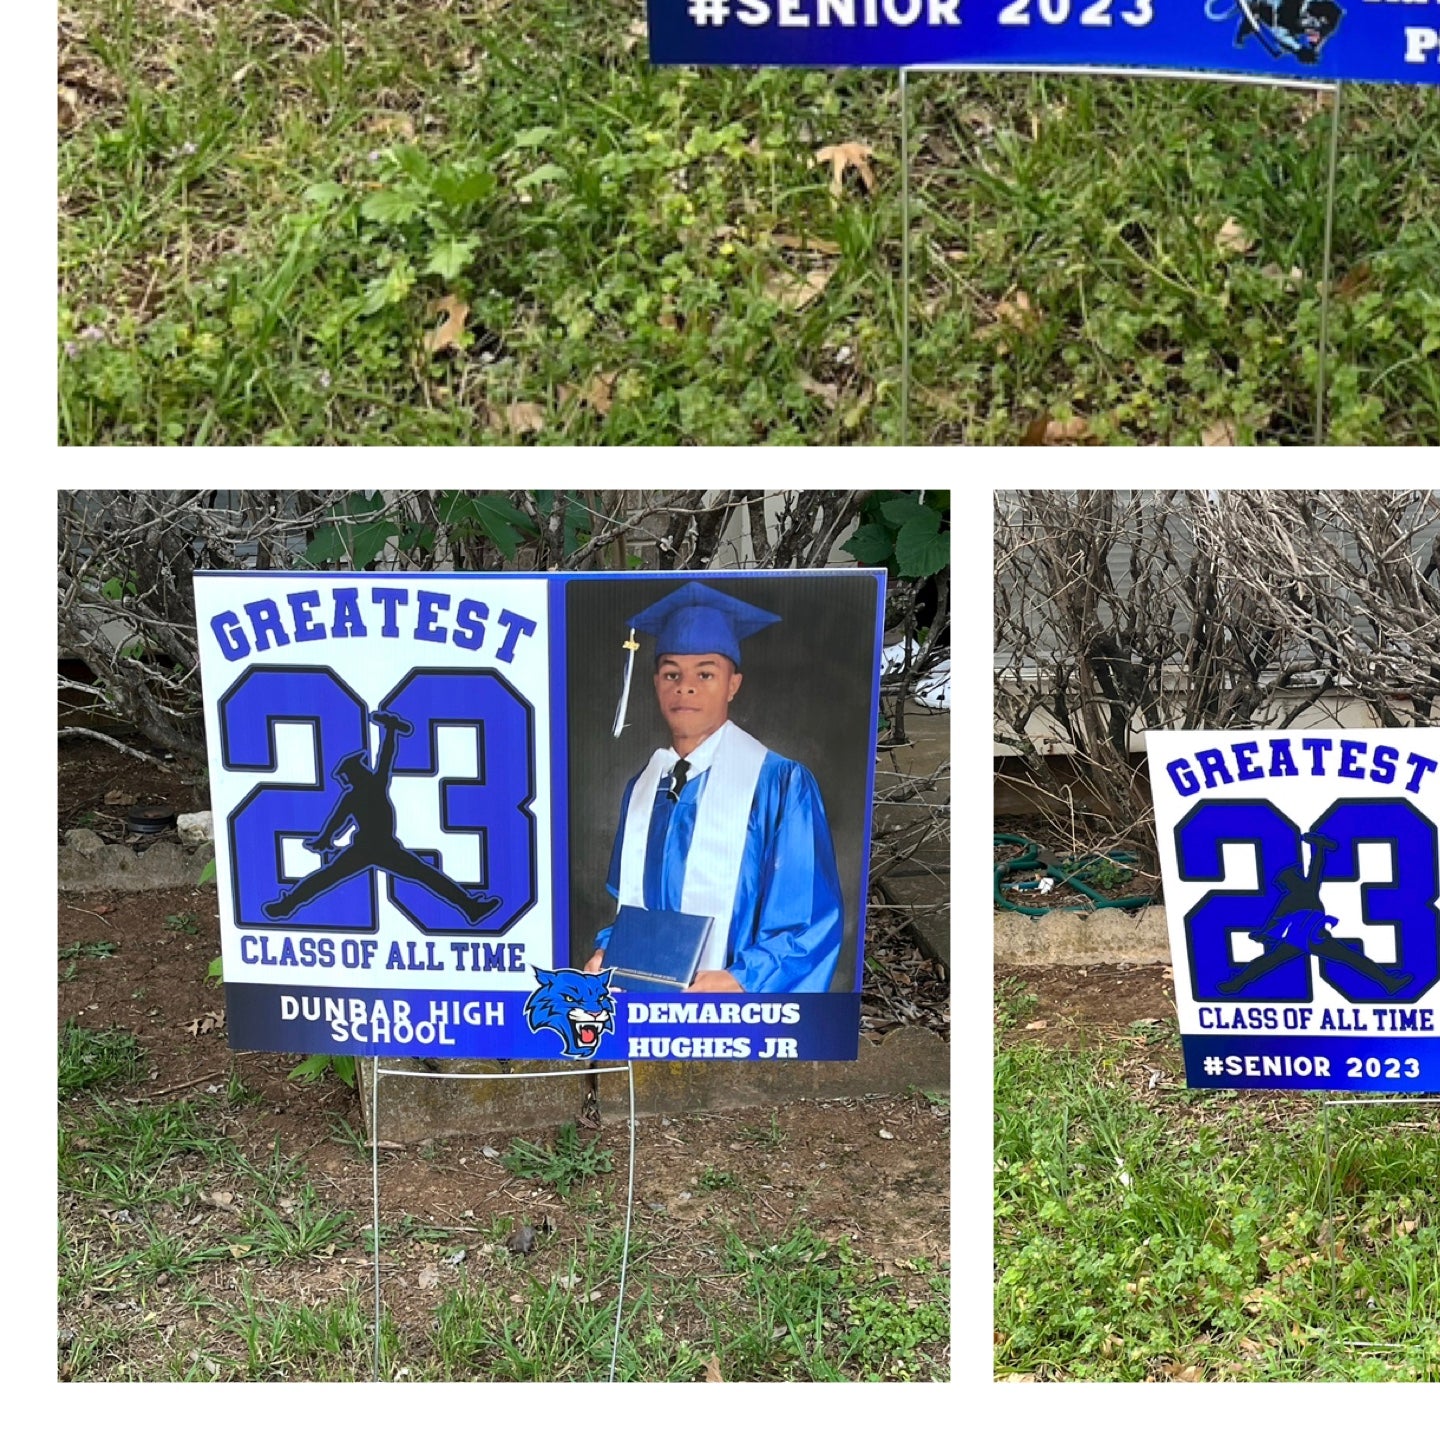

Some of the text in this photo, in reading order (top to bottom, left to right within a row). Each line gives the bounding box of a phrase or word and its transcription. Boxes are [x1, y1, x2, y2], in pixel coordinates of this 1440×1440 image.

[210, 586, 538, 664] GREATEST
[1166, 738, 1438, 797] GREATEST
[217, 663, 538, 936] 23
[241, 934, 526, 972] CLASS OF ALL TIME
[280, 994, 505, 1027] DUNBAR HIGH
[627, 1002, 800, 1025] DEMARCUS
[1199, 1007, 1434, 1032] CLASS OF ALL TIME
[331, 1019, 455, 1046] SCHOOL
[628, 1036, 798, 1059] HUGHES JR
[1203, 1056, 1420, 1078] #SENIOR 2023
